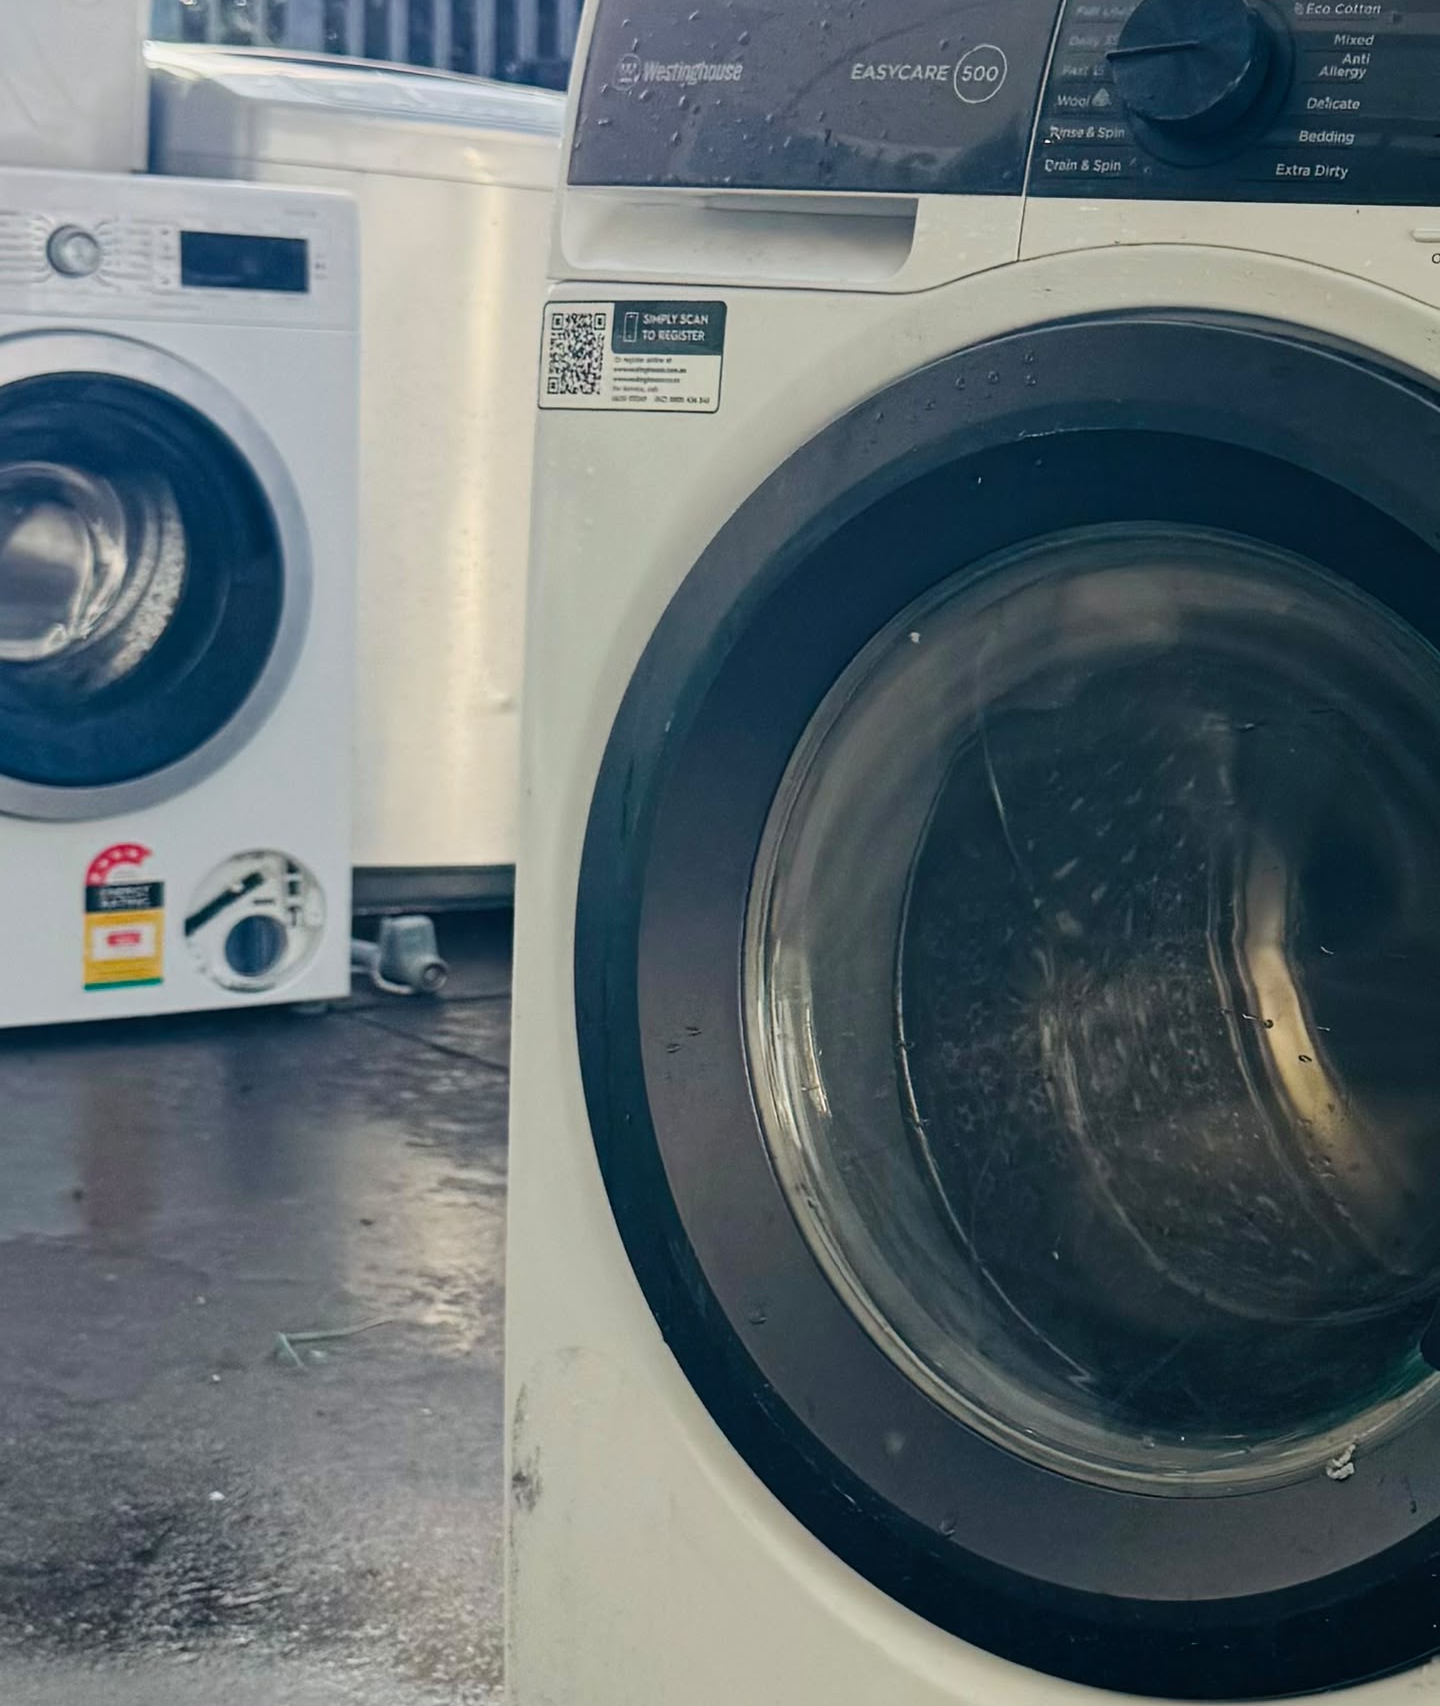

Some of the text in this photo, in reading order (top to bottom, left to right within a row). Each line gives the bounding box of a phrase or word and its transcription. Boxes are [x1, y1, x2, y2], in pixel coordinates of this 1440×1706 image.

[1306, 3, 1382, 15] Eco Cotton
[1334, 34, 1375, 46] Mixed
[1341, 53, 1371, 65] Anti
[643, 61, 743, 86] Westinghouse
[850, 63, 999, 83] EASYCARE 500
[1318, 65, 1367, 80] Allergy
[1056, 95, 1091, 107] Wool
[1306, 96, 1360, 110] Delicate
[1050, 125, 1125, 140] Rinse & Spin
[1299, 129, 1355, 145] Bedding
[1044, 159, 1121, 174] Drain & Spin
[1275, 163, 1349, 179] Extra Dirty
[643, 313, 709, 325] SIMPLY SCAN
[642, 330, 705, 342] TO REGISTER
